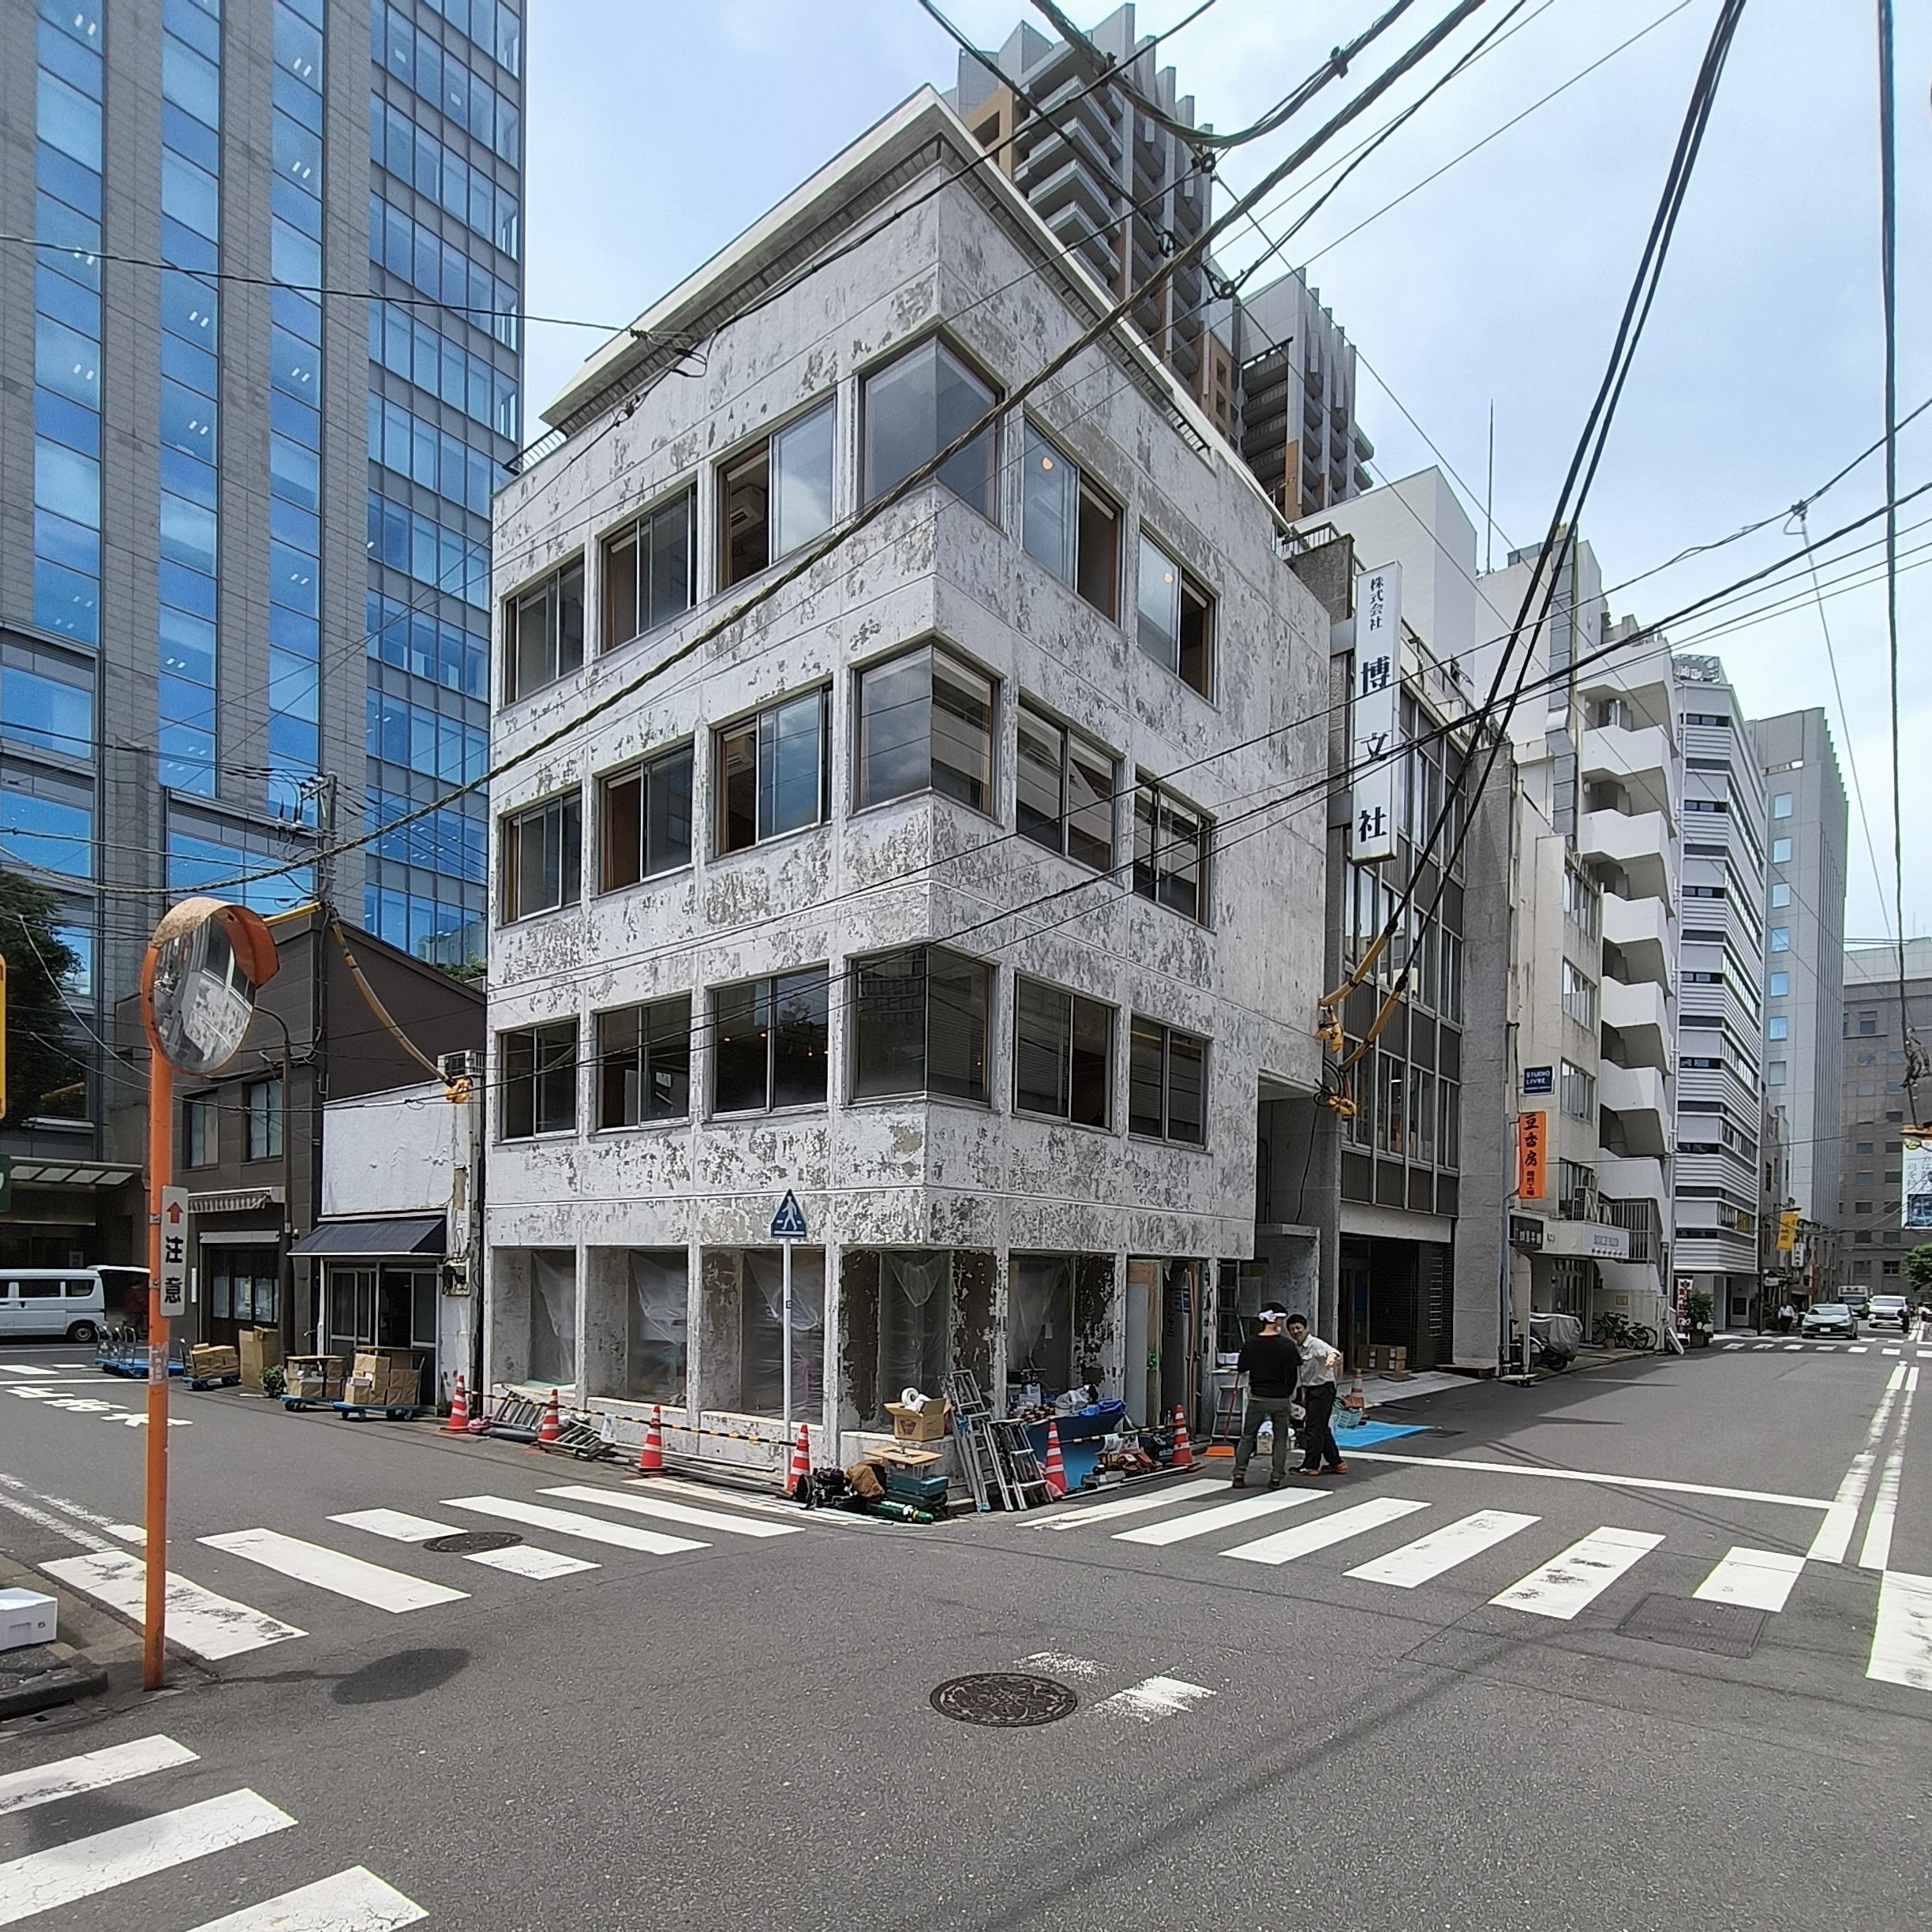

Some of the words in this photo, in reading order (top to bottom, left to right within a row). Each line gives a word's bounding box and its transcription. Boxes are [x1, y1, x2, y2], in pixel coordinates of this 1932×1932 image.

[1369, 575, 1384, 631] 株式会社
[1357, 655, 1391, 843] 博文社
[164, 1236, 184, 1304] 注意
